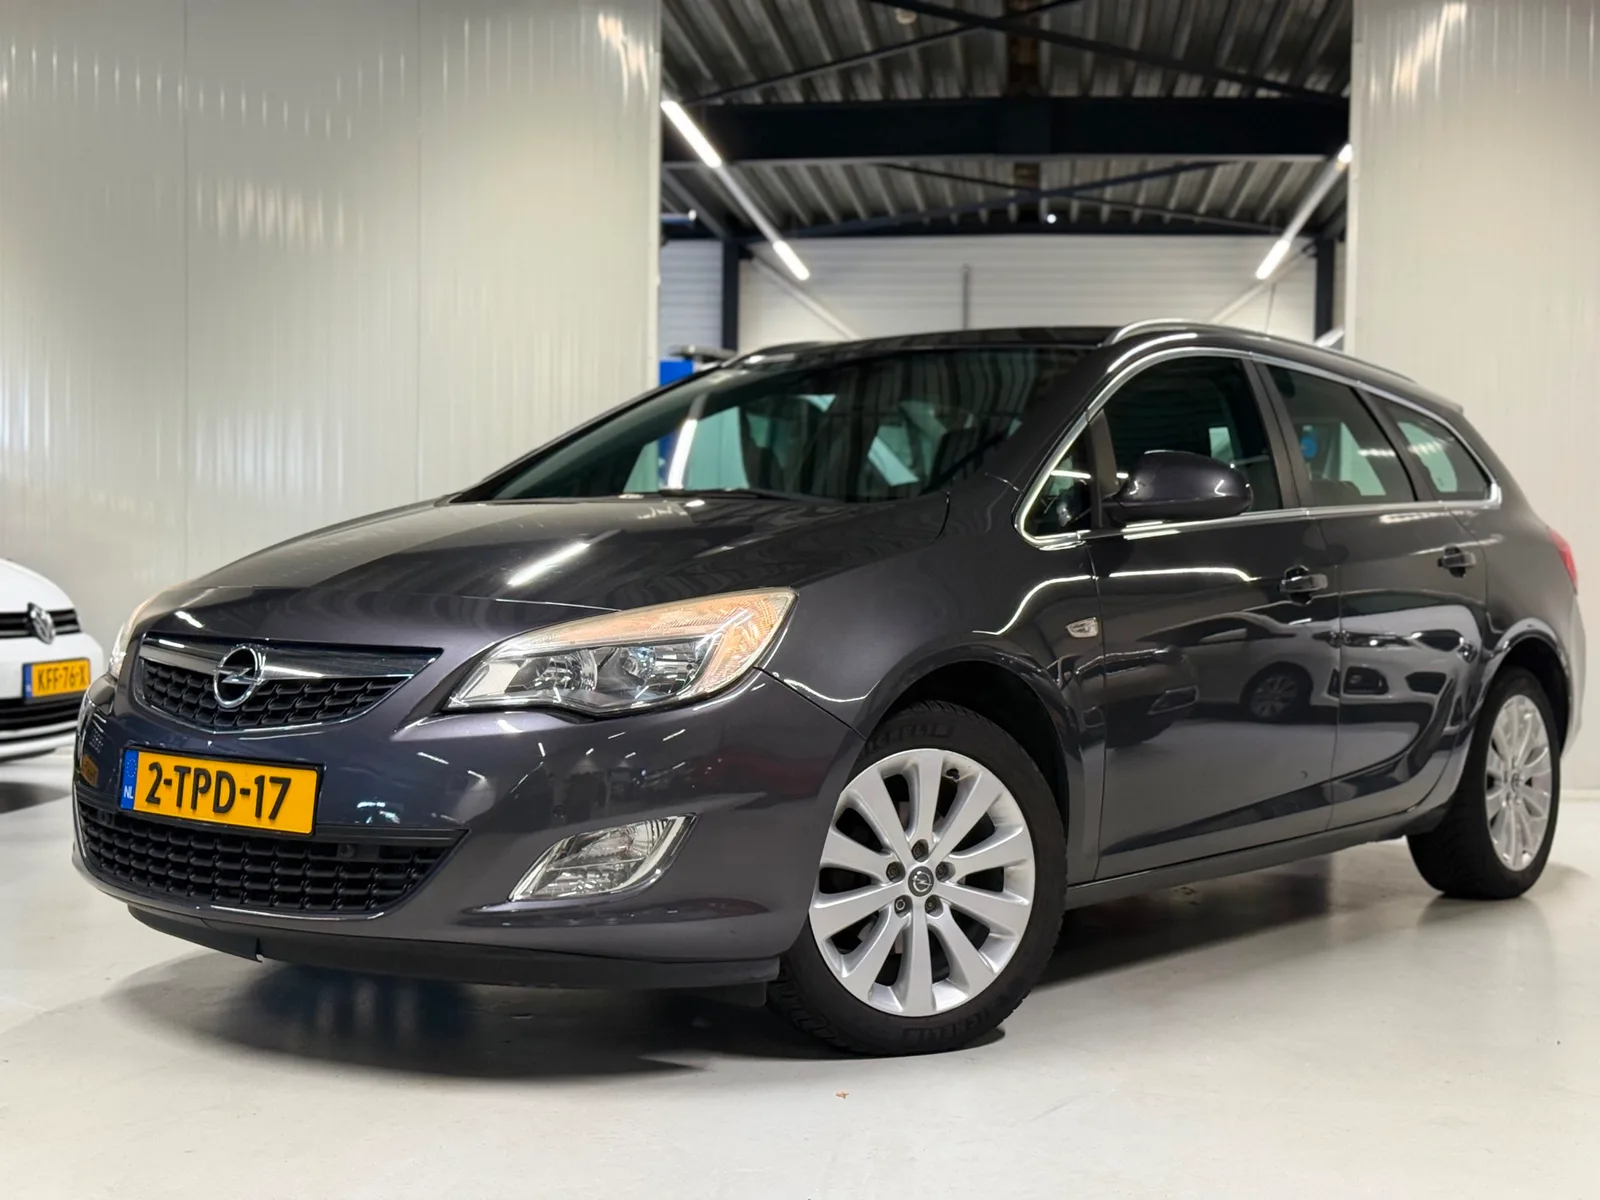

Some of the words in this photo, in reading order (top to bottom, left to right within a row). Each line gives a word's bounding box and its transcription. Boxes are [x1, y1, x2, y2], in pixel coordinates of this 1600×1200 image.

[37, 664, 87, 692] KFF-76-X
[123, 785, 134, 799] NL
[145, 761, 292, 820] 2-TPD-17
